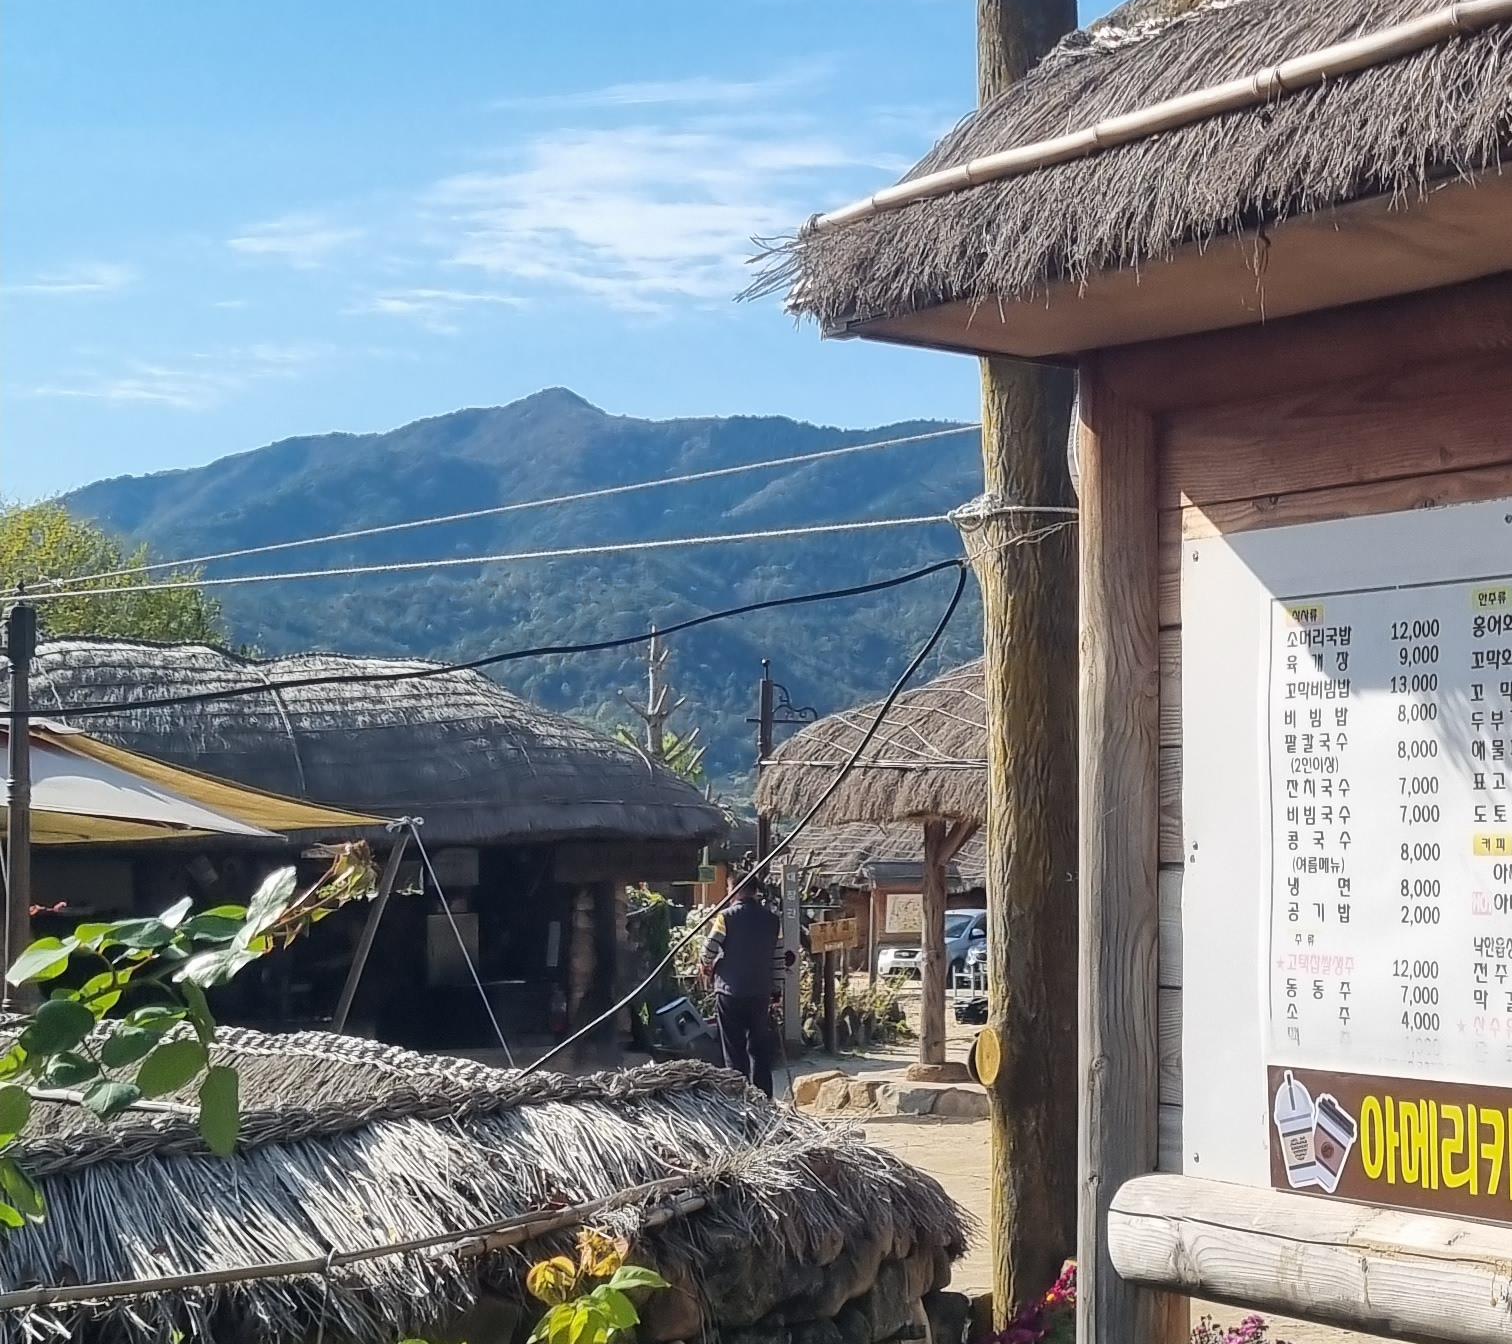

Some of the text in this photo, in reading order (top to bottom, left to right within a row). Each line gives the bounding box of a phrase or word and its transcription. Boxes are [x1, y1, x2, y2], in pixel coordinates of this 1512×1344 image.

[1287, 619, 1440, 648] 소머리국밥 12,000
[1399, 645, 1439, 668] 9,000
[1285, 673, 1438, 700] 꼬막비빔밥 13,000
[1398, 703, 1437, 725] 8,000
[1397, 740, 1438, 761] 8,000
[1291, 756, 1339, 774] (2인이상)
[1399, 776, 1439, 798] 7,000
[1400, 804, 1440, 826] 7,000
[1400, 842, 1441, 864] 8,000
[1292, 856, 1345, 874] (여름메뉴)
[1400, 879, 1441, 900] 8,000
[1400, 905, 1441, 927] 2,000
[1392, 959, 1439, 980] 12,000
[1400, 985, 1439, 1006] 7,000
[1401, 1011, 1440, 1032] 4,000
